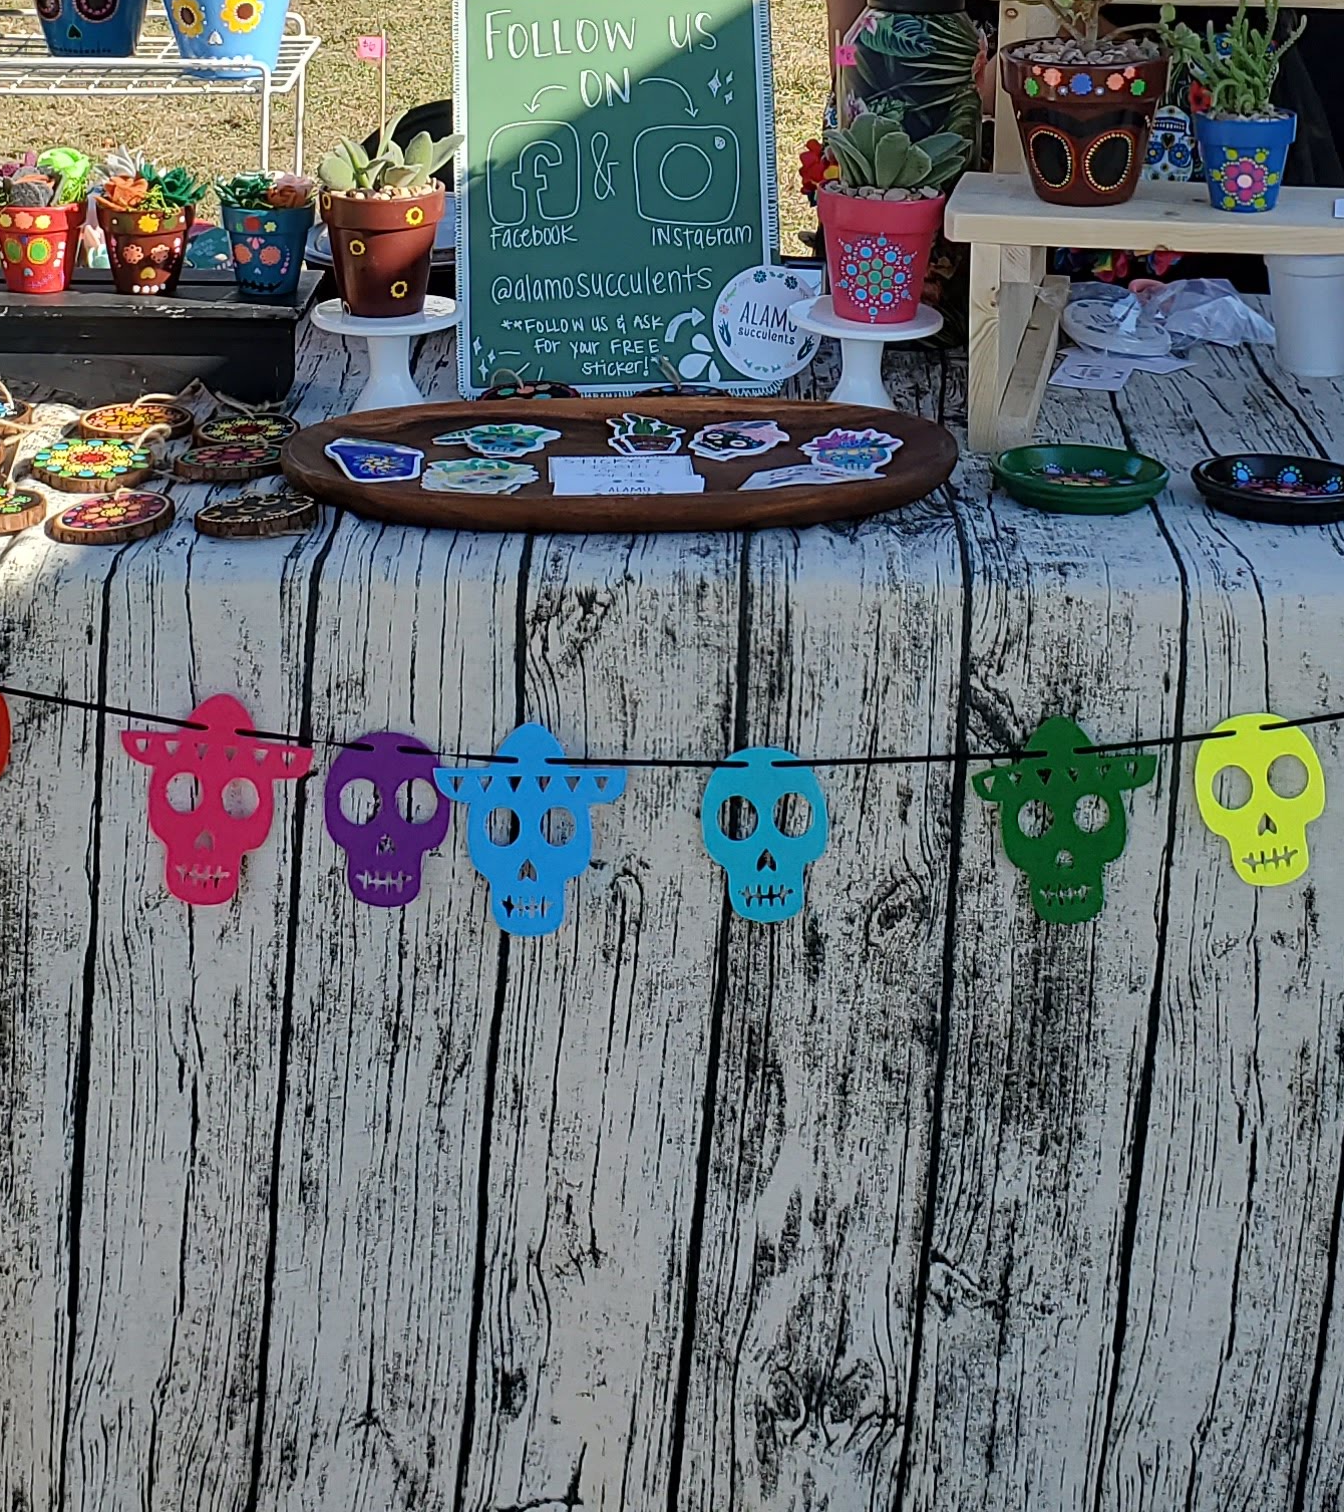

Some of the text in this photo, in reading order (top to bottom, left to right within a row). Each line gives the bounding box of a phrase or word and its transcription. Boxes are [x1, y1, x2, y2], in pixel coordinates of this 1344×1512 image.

[485, 9, 717, 61] FOLLOW US
[579, 67, 631, 108] ON
[590, 132, 619, 200] &
[491, 264, 713, 305] @alamosucculents
[591, 317, 609, 332] US
[634, 314, 664, 329] ASK
[738, 326, 795, 345] succulents
[570, 339, 600, 359] your
[610, 338, 659, 354] FREE
